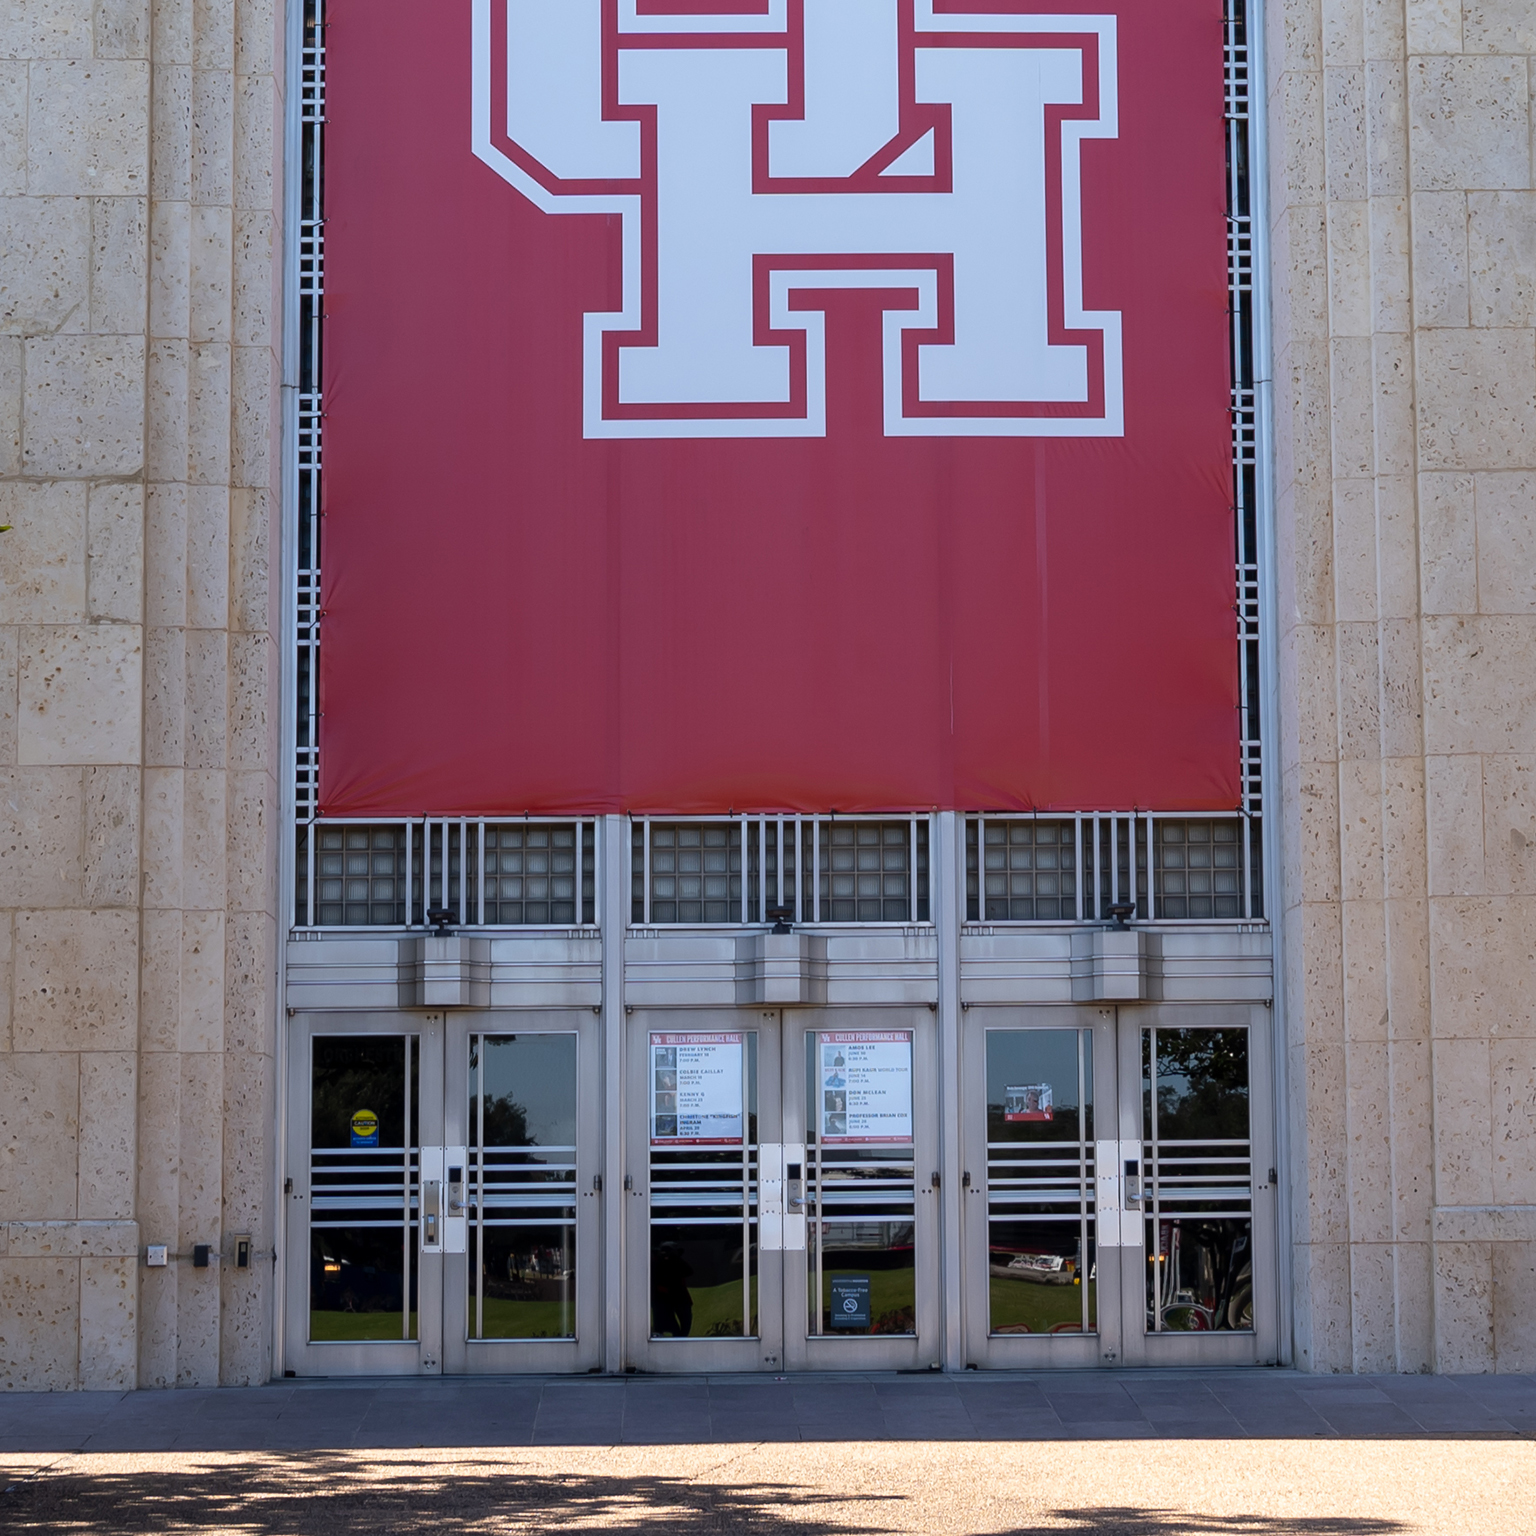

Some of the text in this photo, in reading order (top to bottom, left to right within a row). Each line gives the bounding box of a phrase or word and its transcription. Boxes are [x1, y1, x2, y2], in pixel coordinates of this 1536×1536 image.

[667, 1035, 686, 1044] CULLEN
[687, 1035, 725, 1044] PERFORMANCE
[726, 1034, 740, 1043] HALL
[835, 1033, 855, 1042] CULLEN
[856, 1033, 894, 1042] PERFORMANCE
[895, 1032, 908, 1041] HALL
